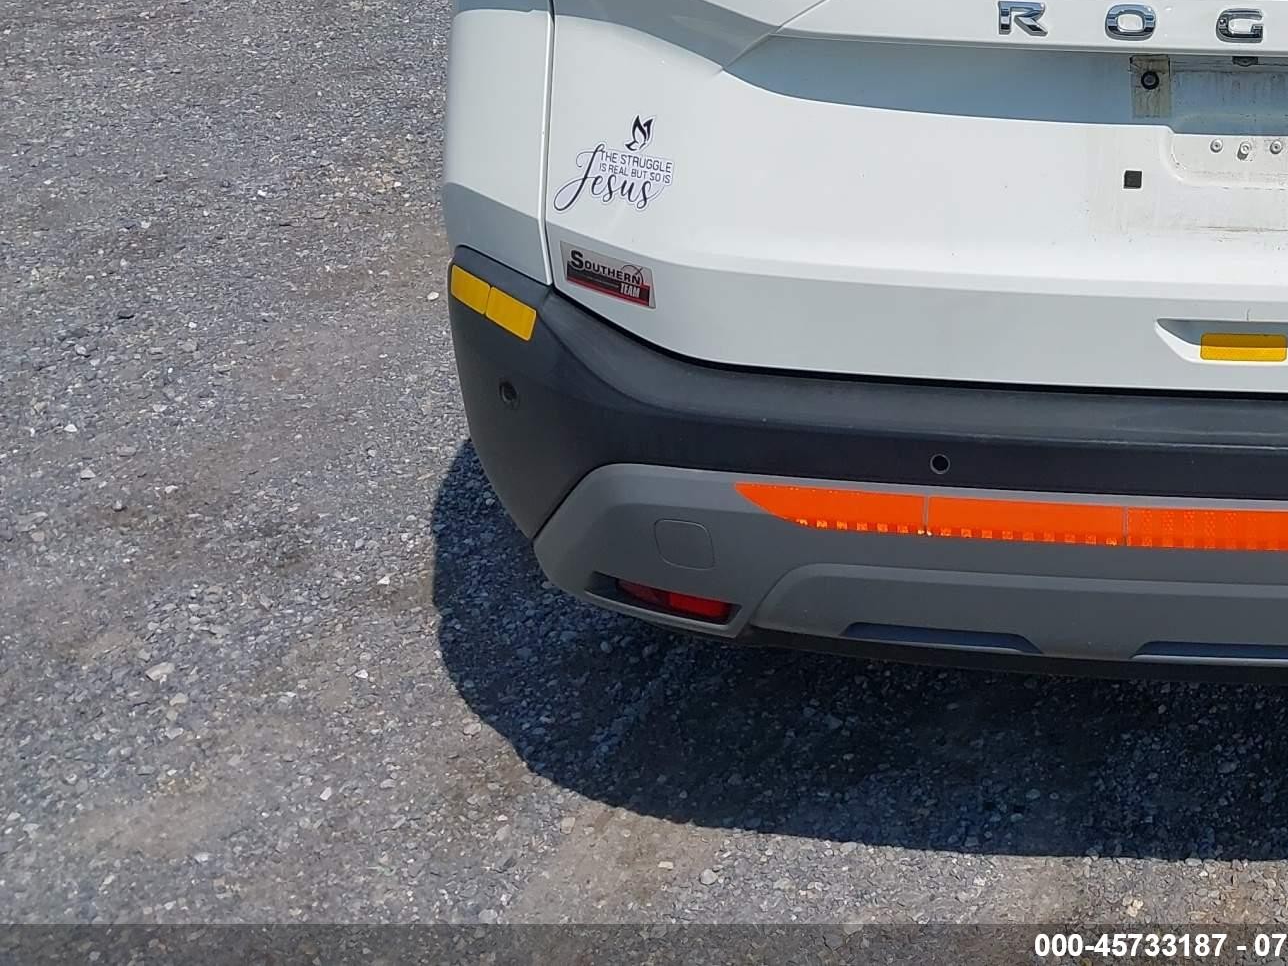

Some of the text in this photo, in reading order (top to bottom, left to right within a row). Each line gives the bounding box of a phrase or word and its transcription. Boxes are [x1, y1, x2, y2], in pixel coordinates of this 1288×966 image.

[599, 163, 671, 184] IS REAL BUT SO IS
[600, 150, 673, 174] THE STRUGGLE
[554, 144, 665, 211] Jesus
[570, 250, 641, 285] SOUTHERN
[620, 282, 640, 298] TEAM
